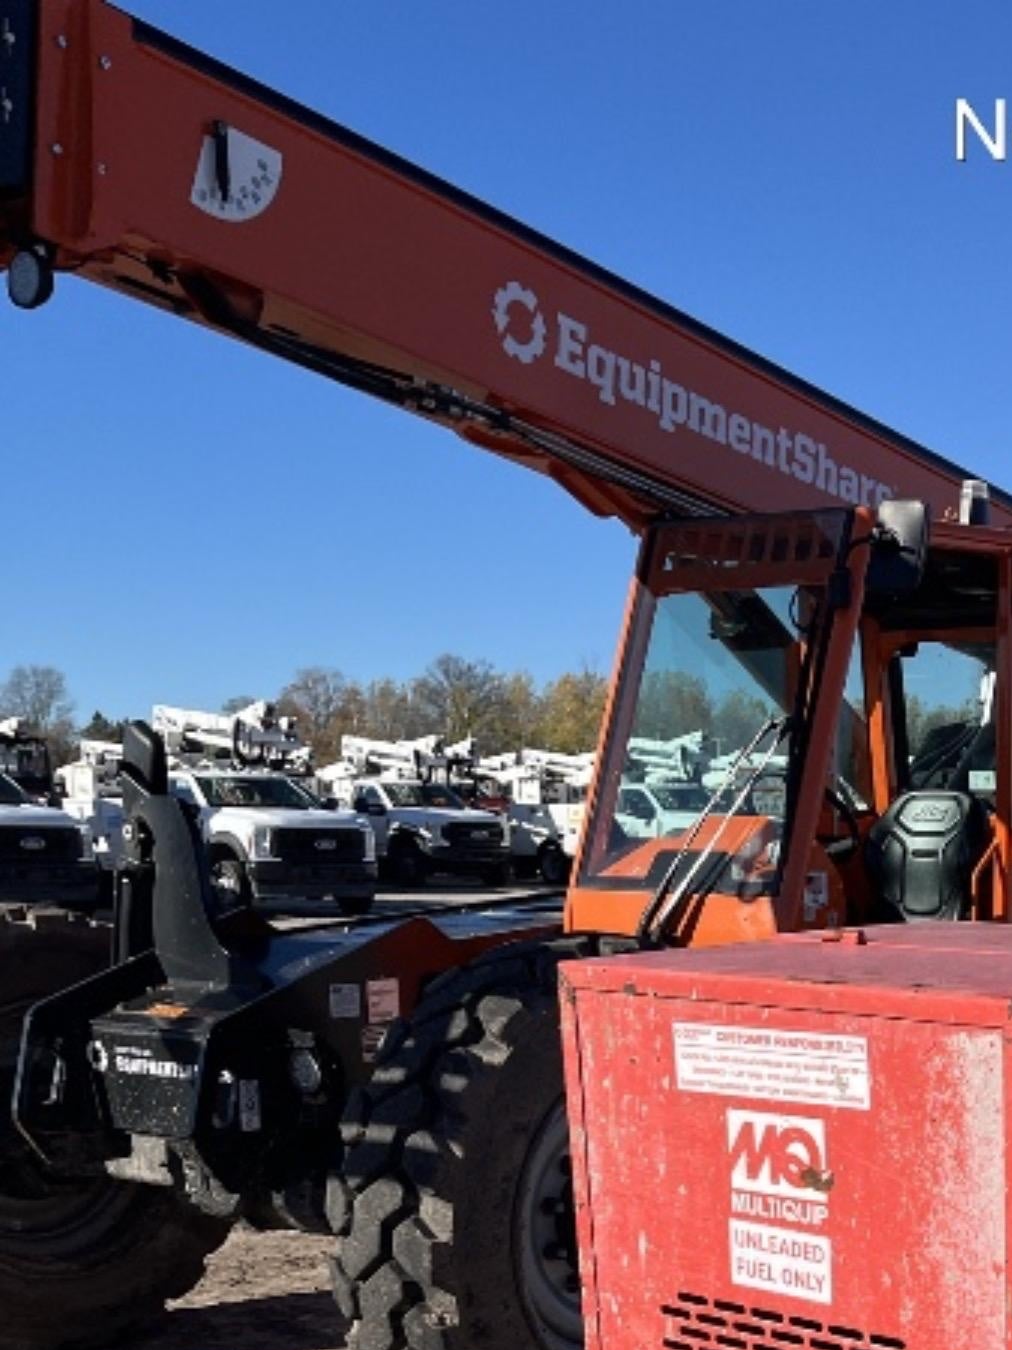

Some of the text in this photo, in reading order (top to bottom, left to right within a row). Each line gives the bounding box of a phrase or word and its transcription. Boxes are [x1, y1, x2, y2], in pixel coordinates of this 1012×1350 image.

[729, 1121, 824, 1190] MQ
[732, 1193, 829, 1226] MULTIQUIP
[734, 1228, 826, 1264] UNLEADED
[737, 1256, 826, 1293] FUEL ONLY
